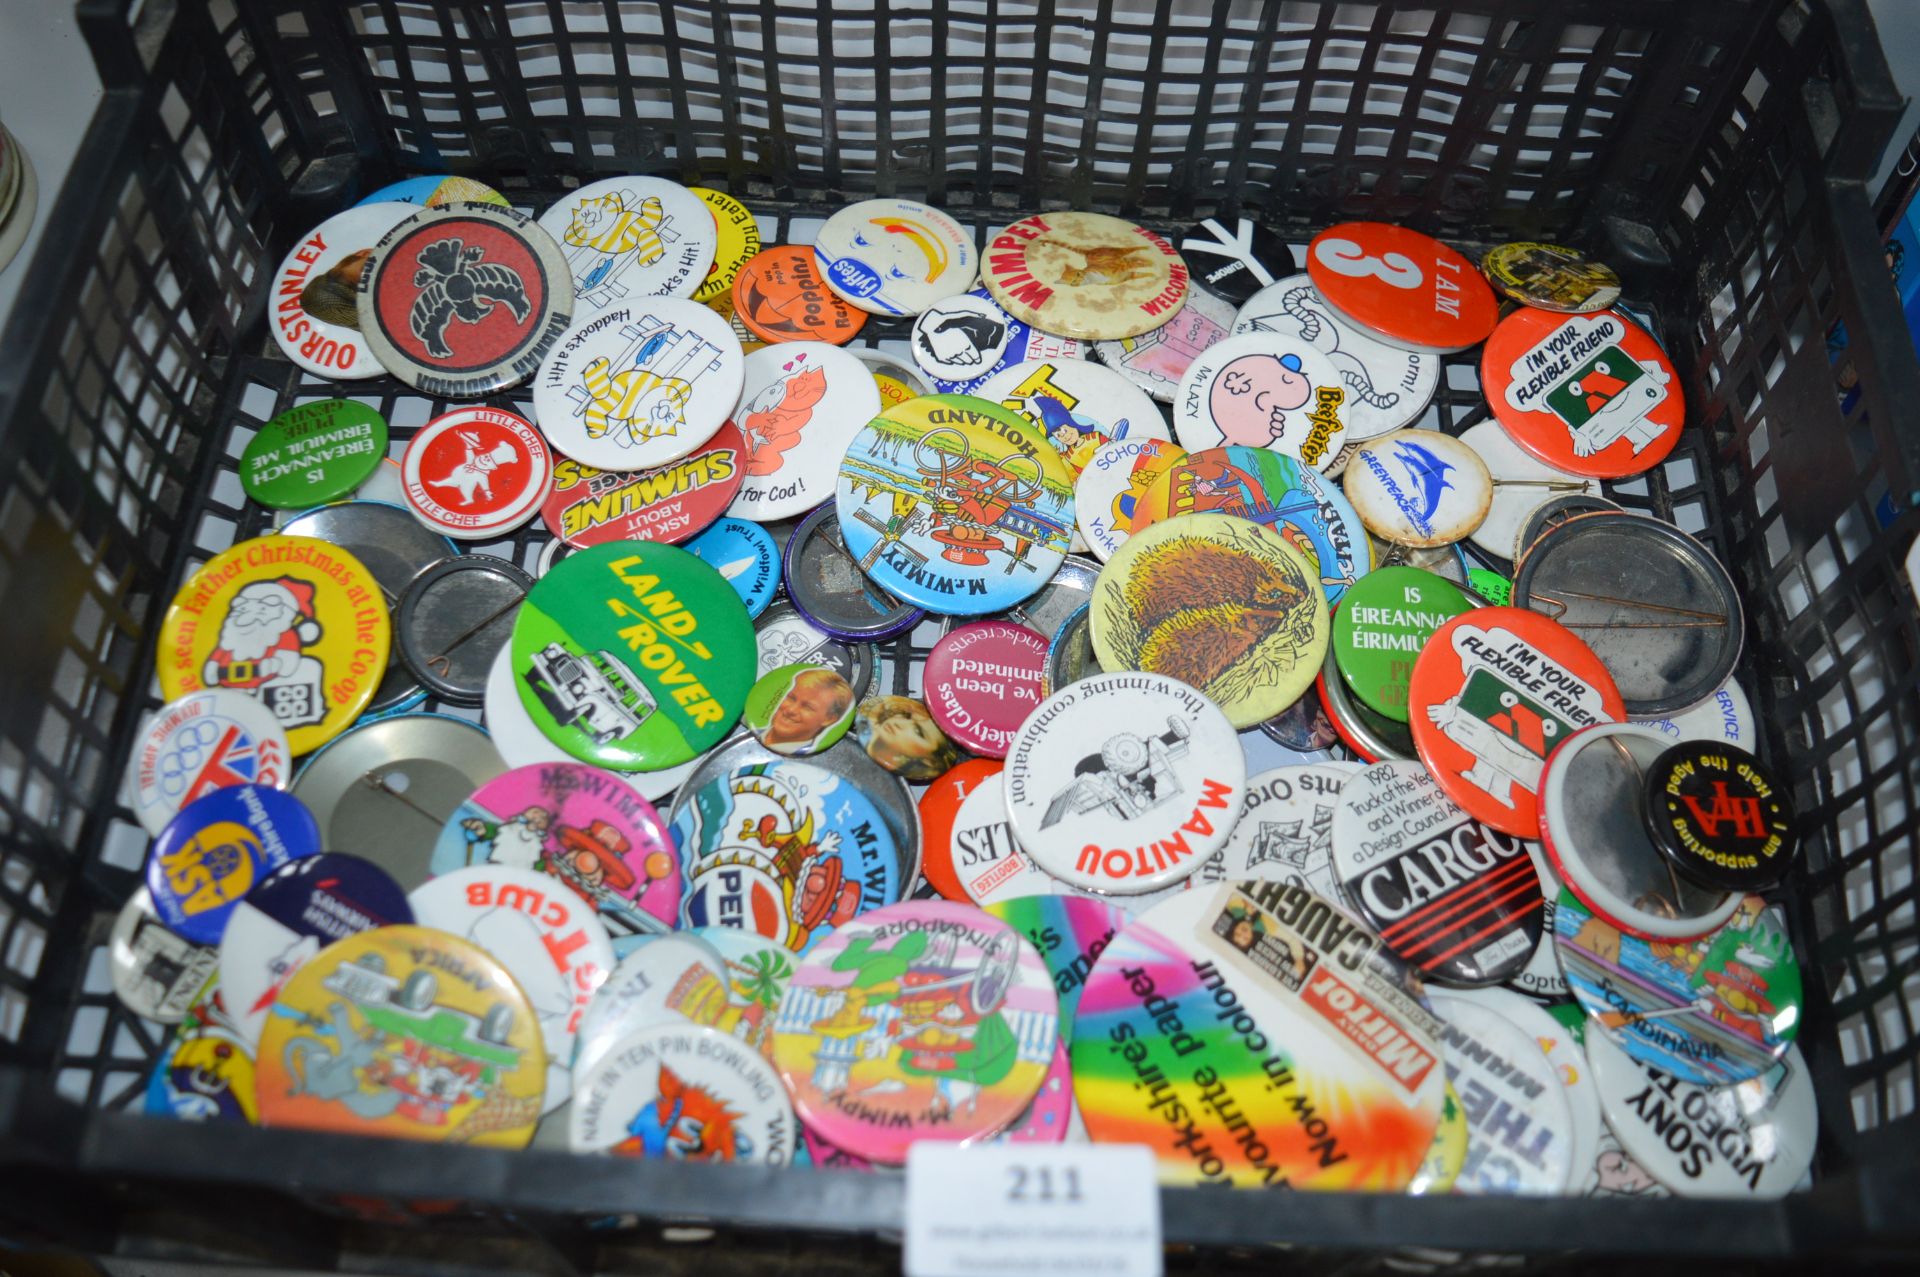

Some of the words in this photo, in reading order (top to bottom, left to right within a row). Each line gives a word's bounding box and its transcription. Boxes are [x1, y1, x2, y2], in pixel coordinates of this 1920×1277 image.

[706, 193, 748, 225] Eater
[678, 241, 701, 267] Hit!
[728, 224, 761, 273] Happy
[992, 214, 1054, 312] WIMPEY
[1131, 224, 1177, 257] HOME
[678, 268, 690, 284] a
[833, 260, 878, 297] Fyffes
[1205, 259, 1247, 286] EUROPE
[1315, 238, 1423, 289] 3
[1436, 257, 1461, 274] I
[279, 232, 328, 343] STANLEY
[1139, 262, 1188, 317] WELCOME
[1435, 277, 1461, 320] AM
[300, 333, 357, 370] OUR
[565, 308, 632, 353] Haddock's
[1525, 349, 1548, 375] I'M
[1547, 324, 1582, 362] YOUR
[545, 360, 568, 389] Hit!
[559, 350, 570, 361] a
[1195, 365, 1213, 383] Mr
[1399, 349, 1422, 394] orm!
[1515, 356, 1572, 406] FLEXIBLE
[1569, 320, 1615, 371] FRIEND
[1185, 382, 1202, 419] LAZY
[474, 411, 519, 434] LITTLE
[518, 428, 543, 459] CHEF
[927, 408, 1040, 459] HOLLAND
[1302, 387, 1343, 464] Beefeater
[306, 469, 325, 485] IS
[1096, 443, 1163, 471] SCHOOL
[409, 481, 442, 521] LITTLE
[442, 511, 482, 526] CHEF
[562, 450, 733, 538] SLIMLINE
[627, 500, 684, 532] ABOUT
[743, 486, 767, 502] for
[656, 512, 691, 534] ASK
[725, 523, 756, 545] Trust
[183, 557, 245, 616] Father
[246, 541, 357, 588] Christmas
[751, 543, 770, 596] Wildfowl
[346, 585, 373, 608] at
[607, 554, 698, 637] LAND
[1404, 586, 1422, 604] IS
[175, 620, 198, 671] seen
[355, 607, 382, 645] the
[950, 626, 1047, 656] indscreens
[331, 648, 377, 706] Co-op
[617, 622, 725, 729] ROVER
[951, 658, 1046, 683] aminated
[955, 676, 1006, 701] been
[1080, 677, 1173, 699] winning
[1460, 635, 1544, 694] FLEXIBLE
[1543, 689, 1600, 728] FRIEN
[1504, 641, 1538, 667] I'M
[1540, 660, 1587, 702] YOUR
[158, 701, 202, 743] OLYMPIC
[938, 682, 971, 728] Glass
[1715, 690, 1739, 741] ERVICE
[966, 721, 1017, 746] afety
[1363, 763, 1399, 788] 1982
[1666, 760, 1696, 797] Aged
[1699, 755, 1729, 773] the
[1737, 764, 1773, 799] Help
[1346, 795, 1384, 818] Truck
[1382, 784, 1397, 804] of
[1395, 777, 1415, 798] the
[1367, 810, 1394, 832] and
[1393, 791, 1434, 818] Winner
[1074, 778, 1233, 880] MANITOU
[1352, 852, 1363, 864] a
[1361, 826, 1403, 860] Design
[1403, 806, 1449, 837] Council
[1671, 818, 1759, 869] supporting
[1761, 834, 1784, 858] am
[1773, 822, 1788, 831] I
[977, 858, 1019, 893] BOOTLEG
[1360, 822, 1521, 921] CARGO
[873, 917, 1005, 957] SINGAPORE
[1237, 880, 1373, 972] CAUGHT
[409, 947, 493, 992] AFRICA
[1121, 964, 1206, 1058] paper
[1190, 959, 1269, 1053] colour
[1594, 977, 1727, 1062] SCANDINAVIA
[1313, 973, 1435, 1085] Mirror
[582, 1087, 608, 1142] NAME
[600, 1067, 622, 1088] IN
[616, 1041, 655, 1071] TEN
[658, 1035, 692, 1054] PIN
[699, 1037, 776, 1103] BOWLING
[1261, 1056, 1296, 1092] in
[1110, 1020, 1233, 1188] orkshire's
[1460, 1078, 1555, 1172] THE
[1285, 1095, 1349, 1171] Now
[1624, 1086, 1713, 1179] SONY
[1681, 1087, 1768, 1191] VIDEO
[1006, 1164, 1085, 1202] 211
